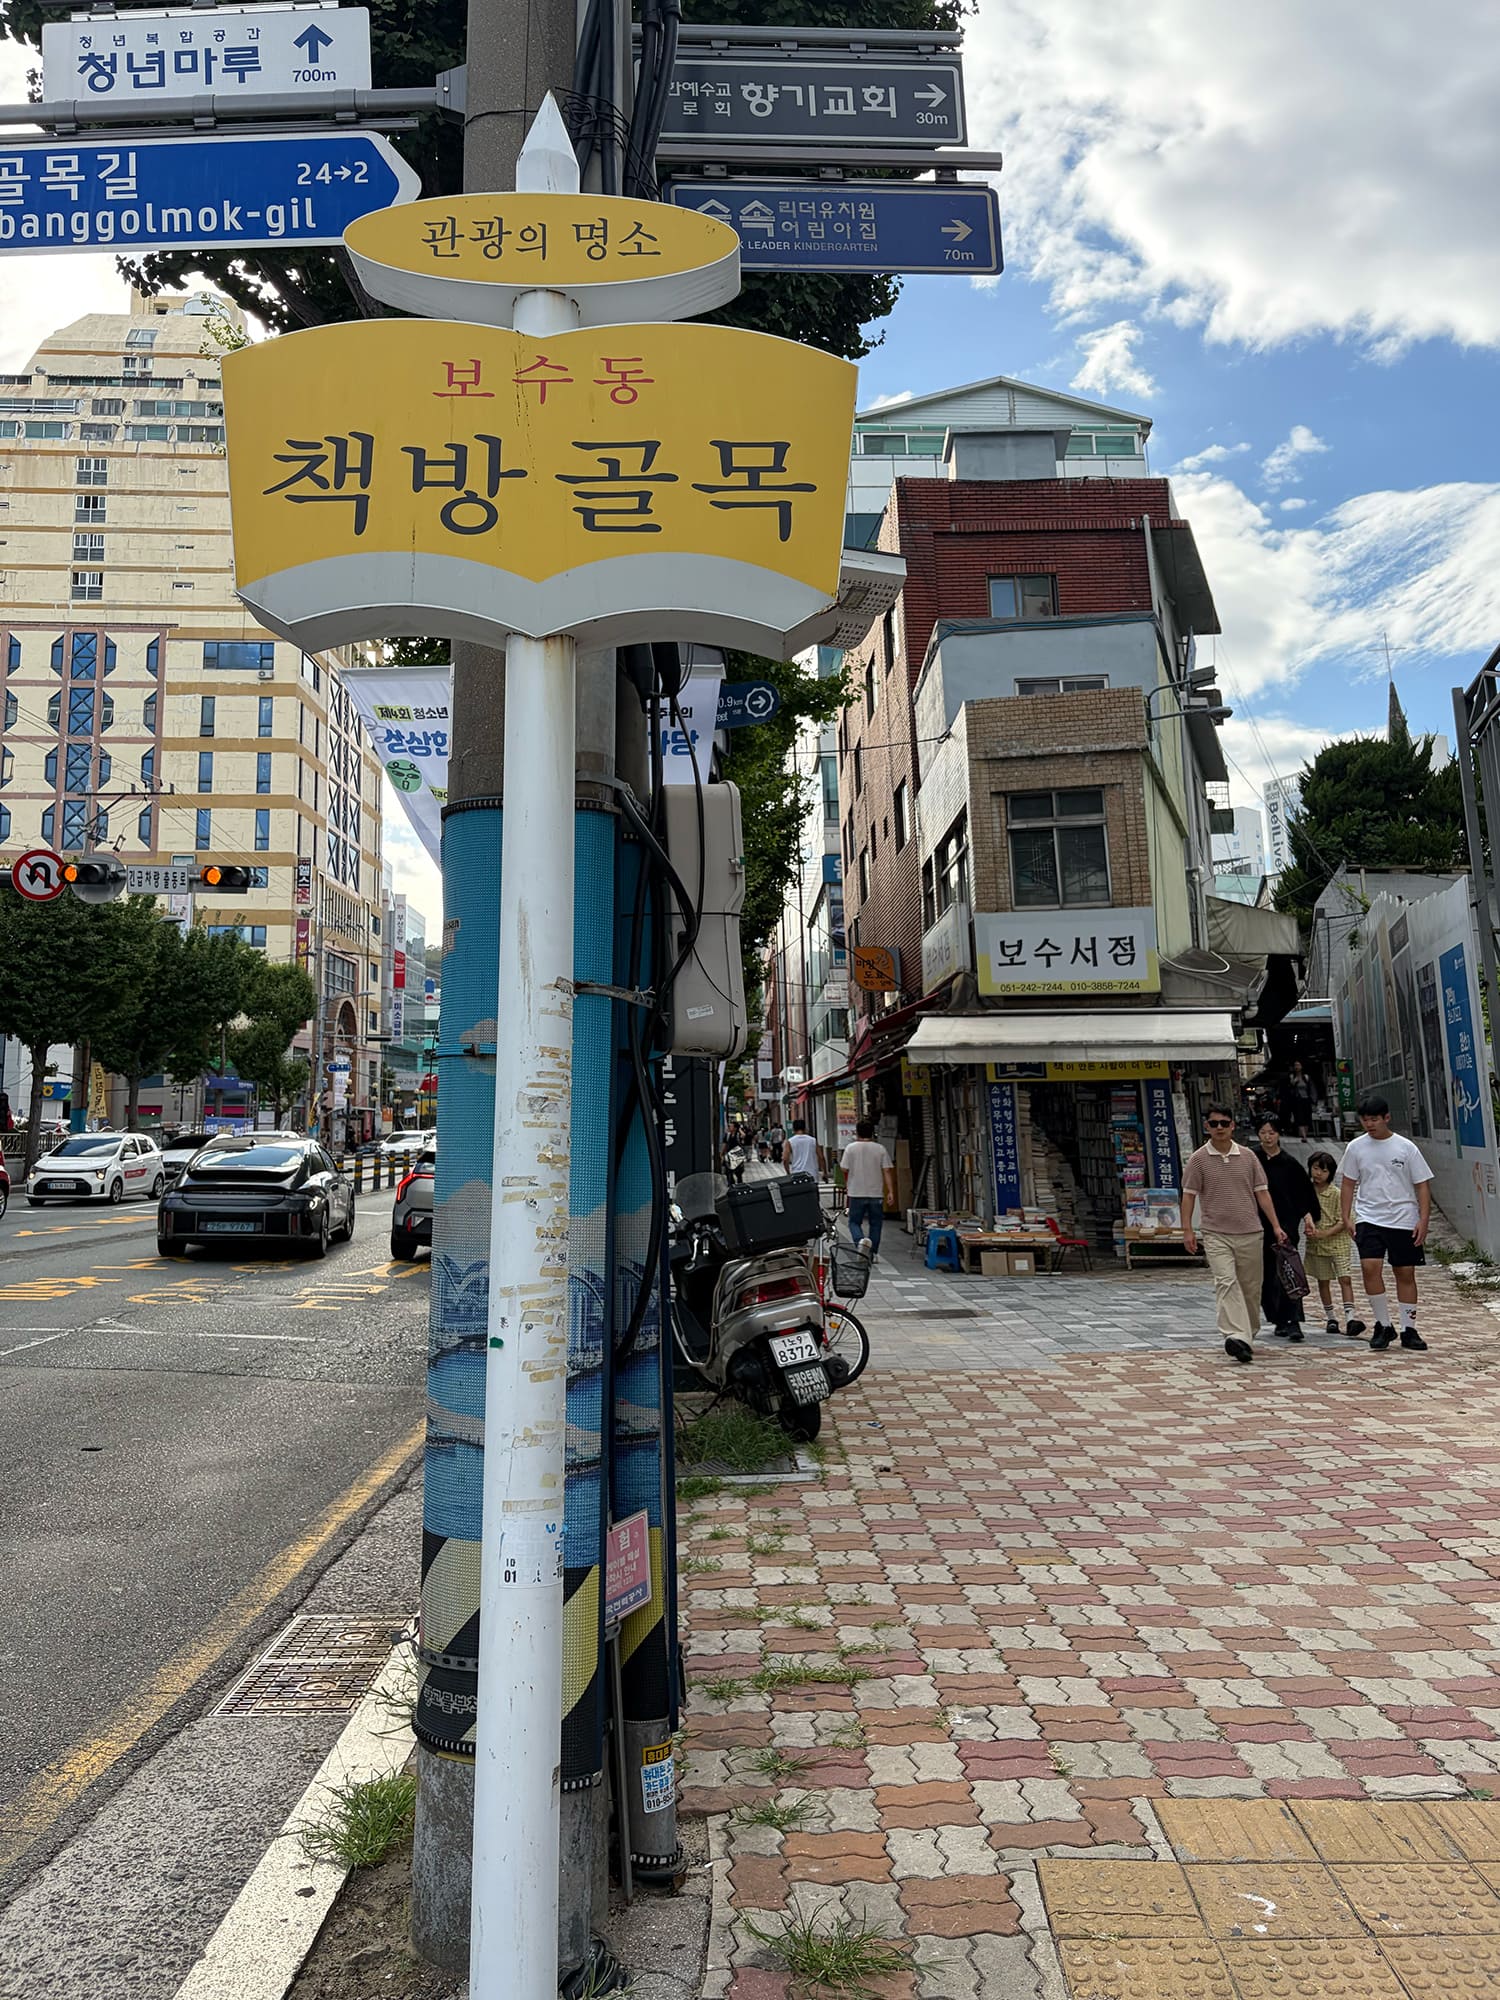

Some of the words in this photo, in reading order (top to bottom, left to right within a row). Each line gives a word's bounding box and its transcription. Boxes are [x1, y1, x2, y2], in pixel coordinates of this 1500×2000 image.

[79, 27, 262, 48] 청년복합공간
[77, 46, 262, 93] 청년마루
[292, 69, 337, 83] 700m
[740, 82, 897, 118] 향기교회
[915, 111, 949, 126] 30m
[778, 200, 876, 220] 리더유치원
[0, 198, 316, 243] banggolmok-gil
[420, 216, 548, 261] 관광의
[572, 217, 662, 261] 명소
[747, 241, 791, 250] LEADER
[793, 241, 878, 252] KINDERGARTEN
[942, 248, 975, 261] 70m
[432, 355, 656, 405] 보수동
[262, 431, 818, 543] 책방골목
[377, 706, 412, 720] 제4회
[412, 706, 449, 720] 청소년
[998, 935, 1136, 968] 보수서점
[1070, 981, 1140, 992] 010-3858-7244
[778, 1344, 816, 1363] 8372
